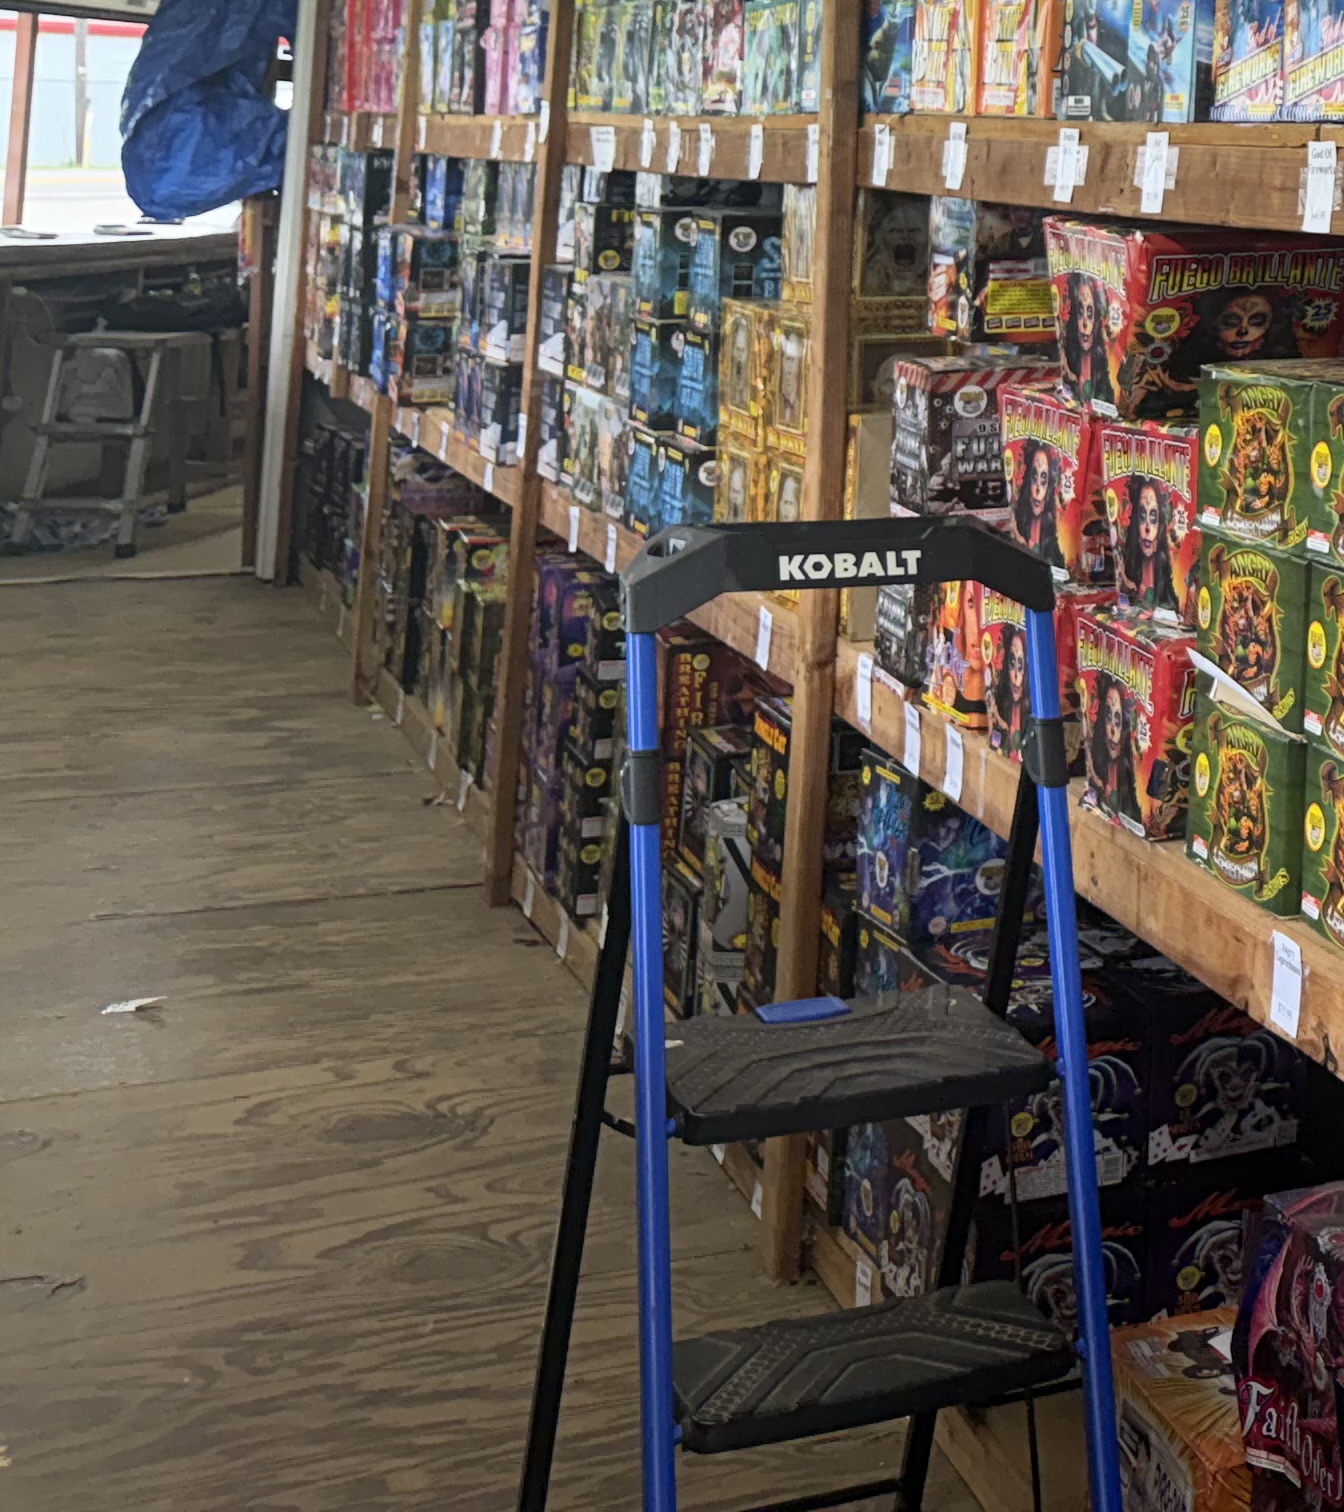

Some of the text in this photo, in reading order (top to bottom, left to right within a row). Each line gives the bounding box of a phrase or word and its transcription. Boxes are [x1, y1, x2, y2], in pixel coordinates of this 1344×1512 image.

[1148, 254, 1226, 304] FUEGO
[778, 549, 922, 581] KOBALT
[1240, 1379, 1301, 1456] Faith
